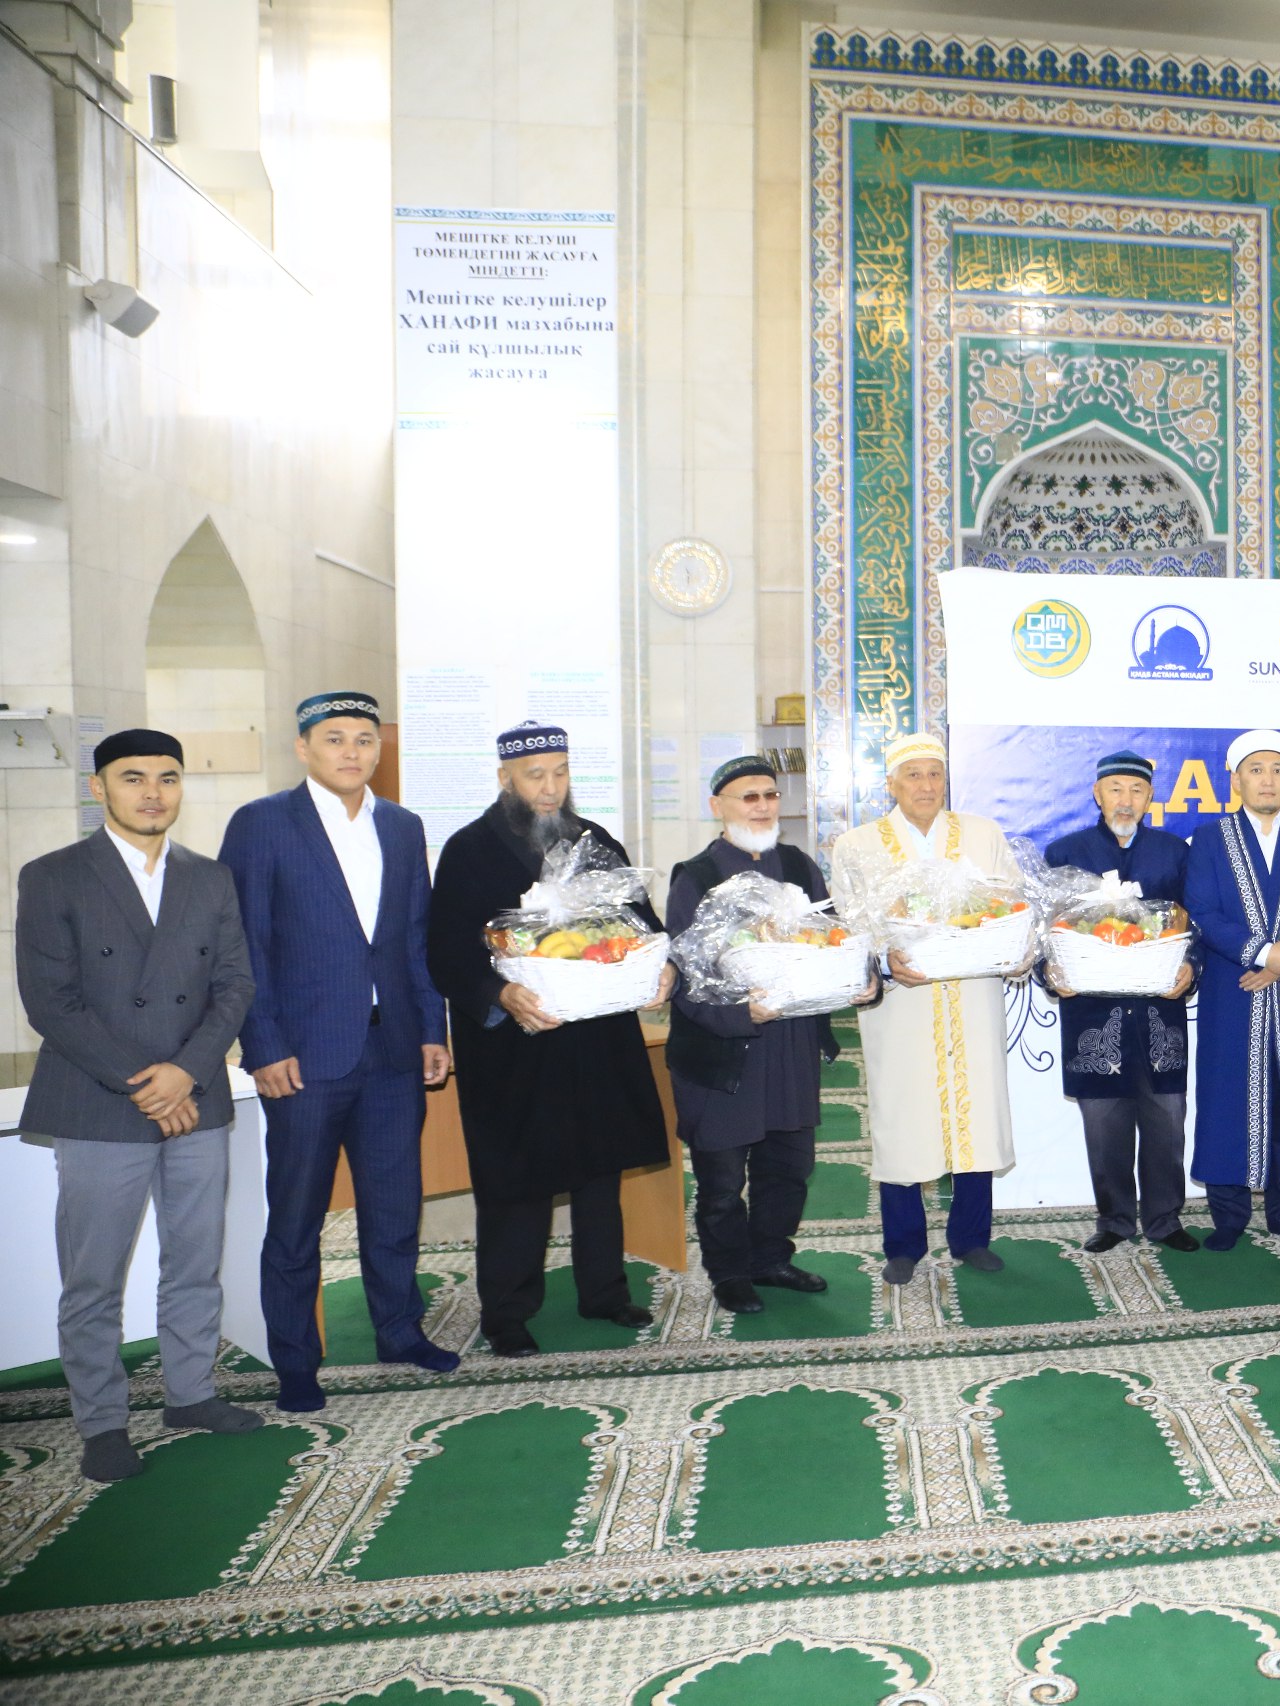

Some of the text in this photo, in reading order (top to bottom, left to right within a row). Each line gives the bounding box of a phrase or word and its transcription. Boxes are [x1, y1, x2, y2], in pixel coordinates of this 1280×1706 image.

[435, 231, 577, 246] МЕШІТКЕ КЕЛУШІ
[413, 247, 521, 262] ТӨМЕНДЕГІНІ
[406, 289, 607, 312] Мешітке келушілер
[399, 314, 614, 332] ХАНАФИ мазхабына
[427, 340, 461, 354] сай
